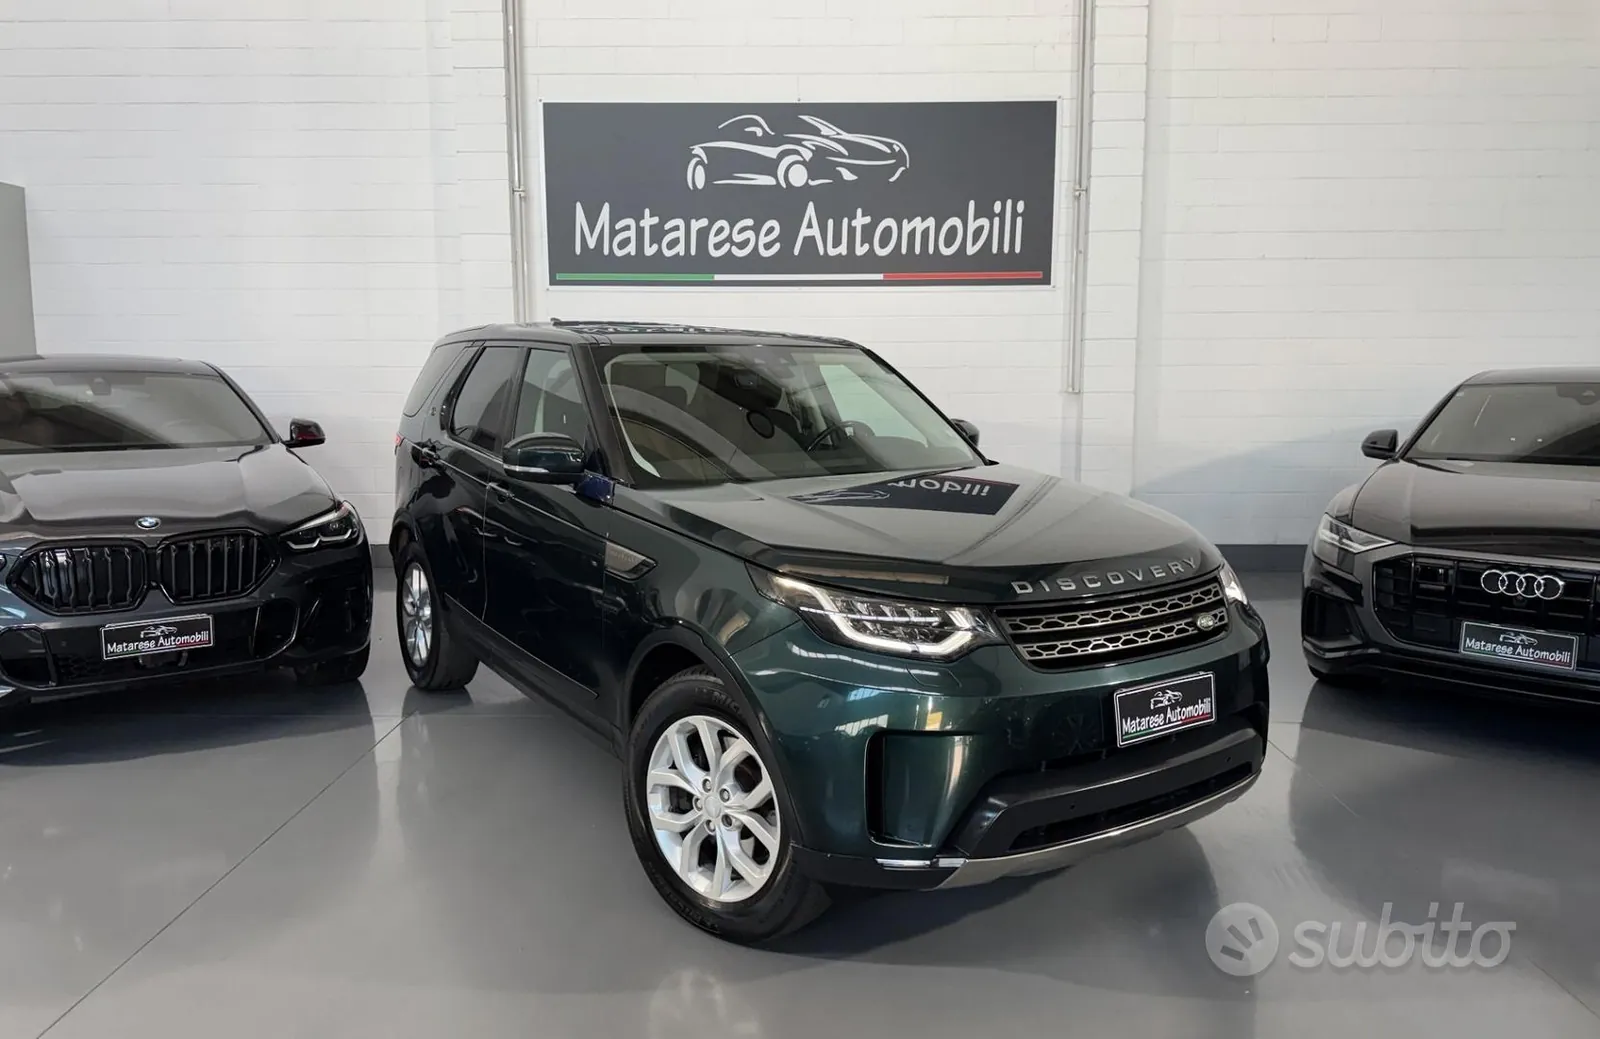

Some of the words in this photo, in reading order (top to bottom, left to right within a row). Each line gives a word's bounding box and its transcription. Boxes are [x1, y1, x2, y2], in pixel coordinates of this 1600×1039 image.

[574, 201, 782, 257] Matarese
[793, 199, 1025, 257] Automobili
[1011, 557, 1197, 594] DISCOVERY
[107, 640, 156, 653] Matarese
[158, 630, 209, 647] Automobili
[1465, 637, 1513, 655] Matarese
[1515, 645, 1571, 663] Automobili
[1122, 713, 1165, 735] Matarese
[1166, 697, 1211, 724] Automobili
